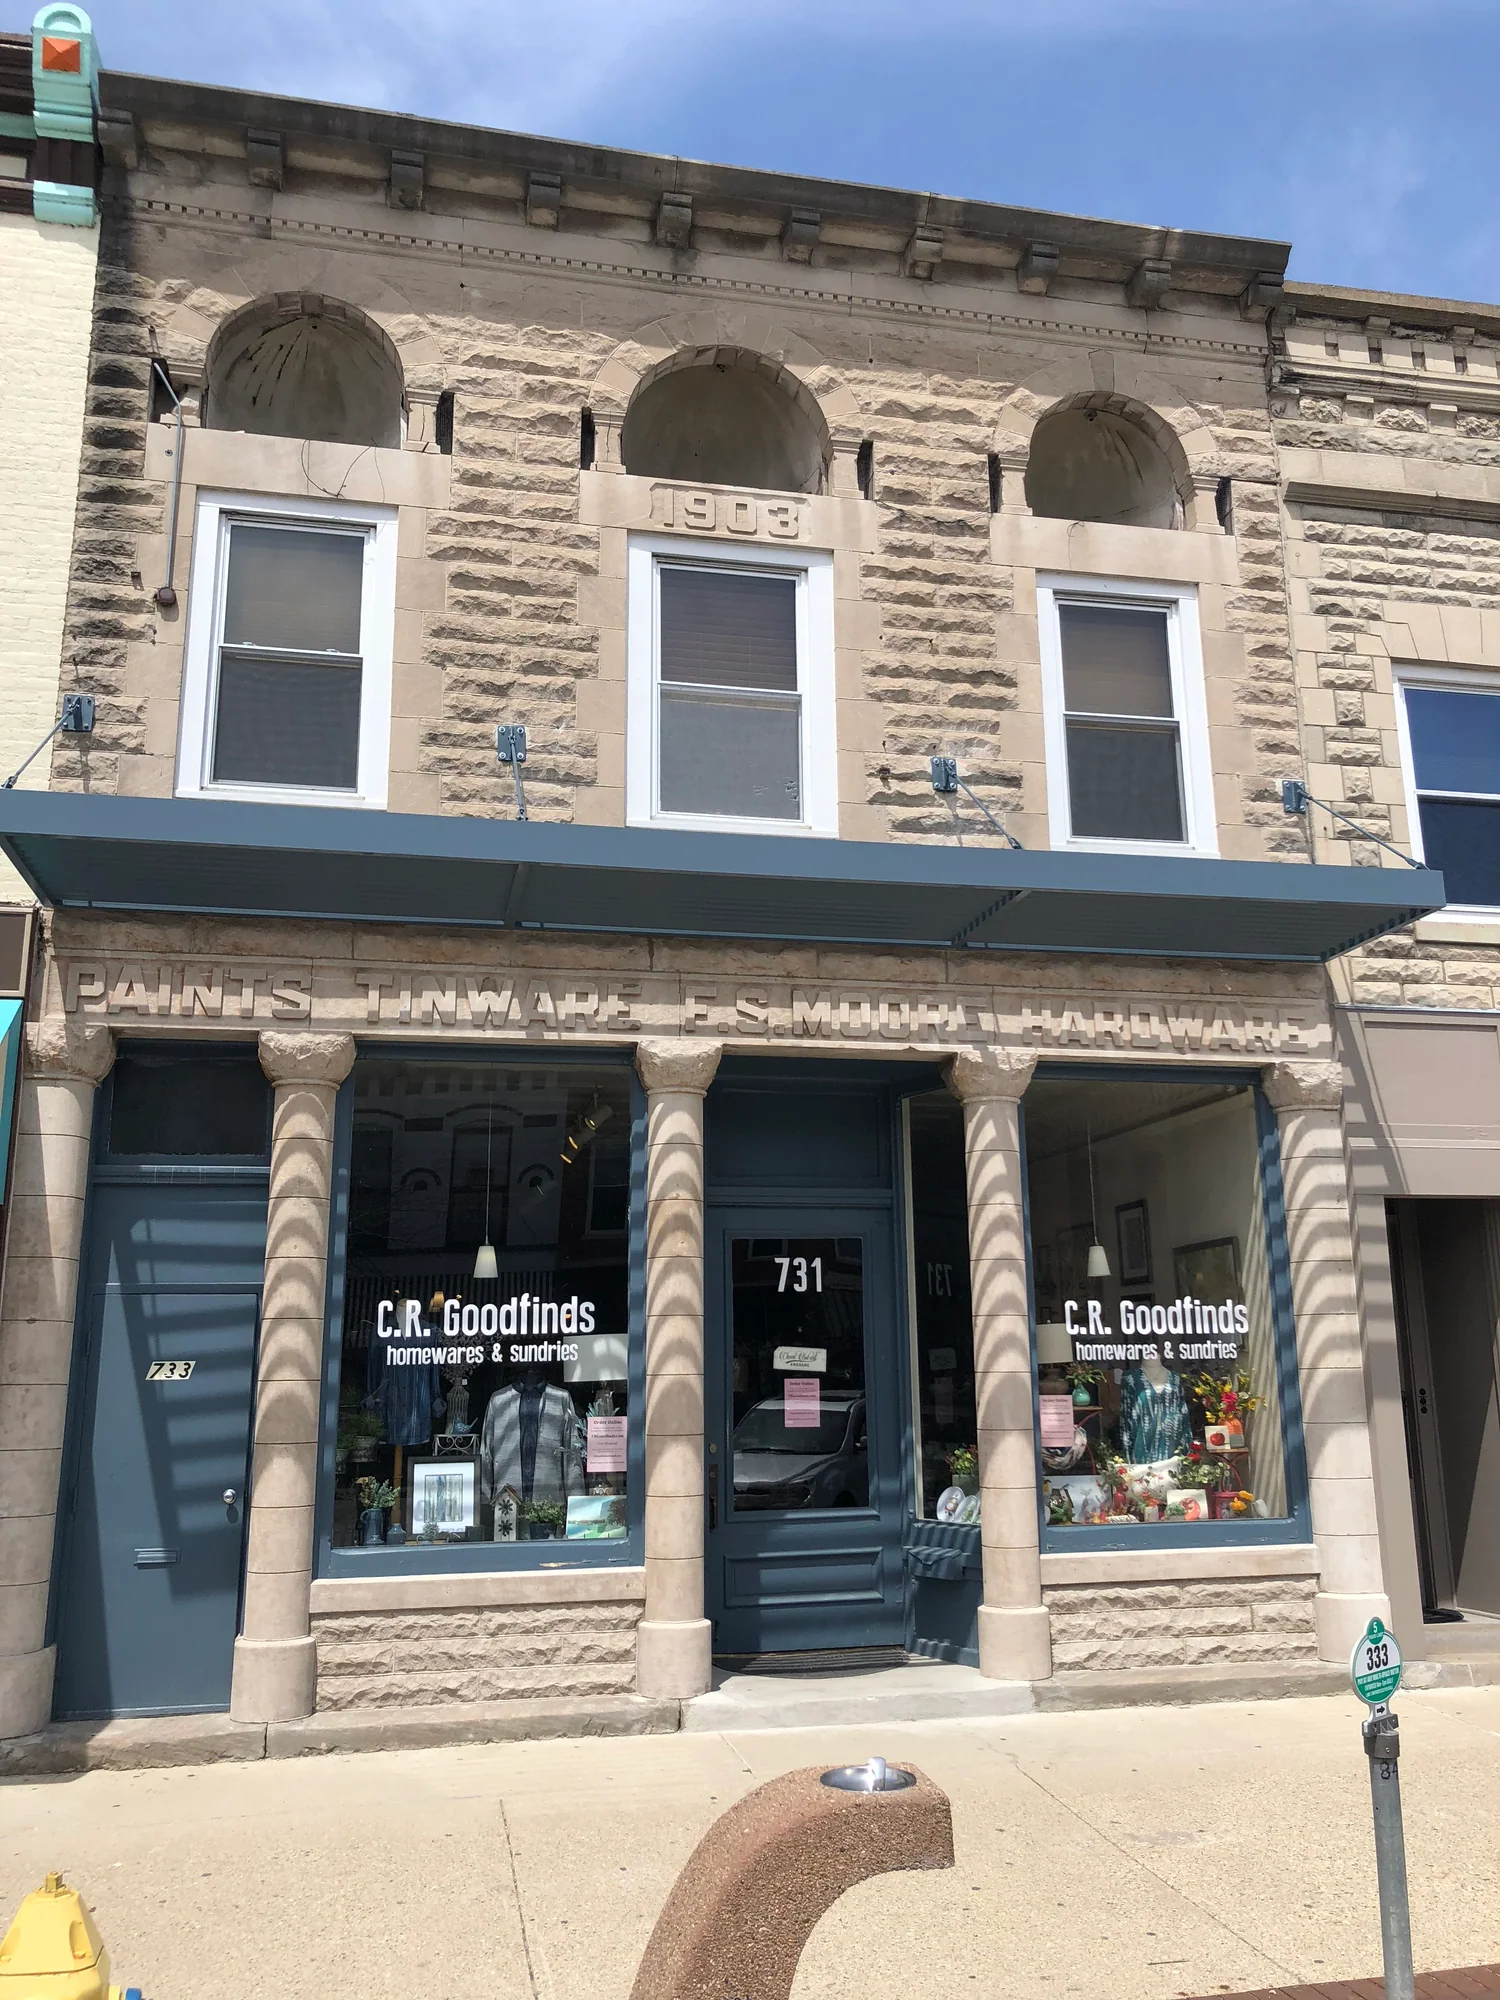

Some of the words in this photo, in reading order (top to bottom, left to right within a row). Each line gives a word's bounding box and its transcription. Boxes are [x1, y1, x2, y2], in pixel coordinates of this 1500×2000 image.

[663, 488, 798, 539] 1903
[65, 962, 311, 1019] PAINTS
[356, 973, 642, 1030] TINWARE
[1022, 1000, 1308, 1053] HARDWARE
[774, 1257, 822, 1292] 731
[377, 1300, 431, 1338] C.R.
[443, 1293, 595, 1336] Goodfinds
[1064, 1300, 1112, 1335] C.R.
[1120, 1295, 1249, 1335] Goodfinds
[387, 1345, 484, 1365] homewares
[491, 1343, 503, 1362] &
[510, 1341, 579, 1362] sundries
[1076, 1341, 1158, 1361] homewares
[1164, 1341, 1174, 1360] &
[1179, 1340, 1238, 1360] sundries
[149, 1362, 191, 1379] 733
[1373, 1621, 1378, 1633] 5
[1366, 1643, 1389, 1671] 333
